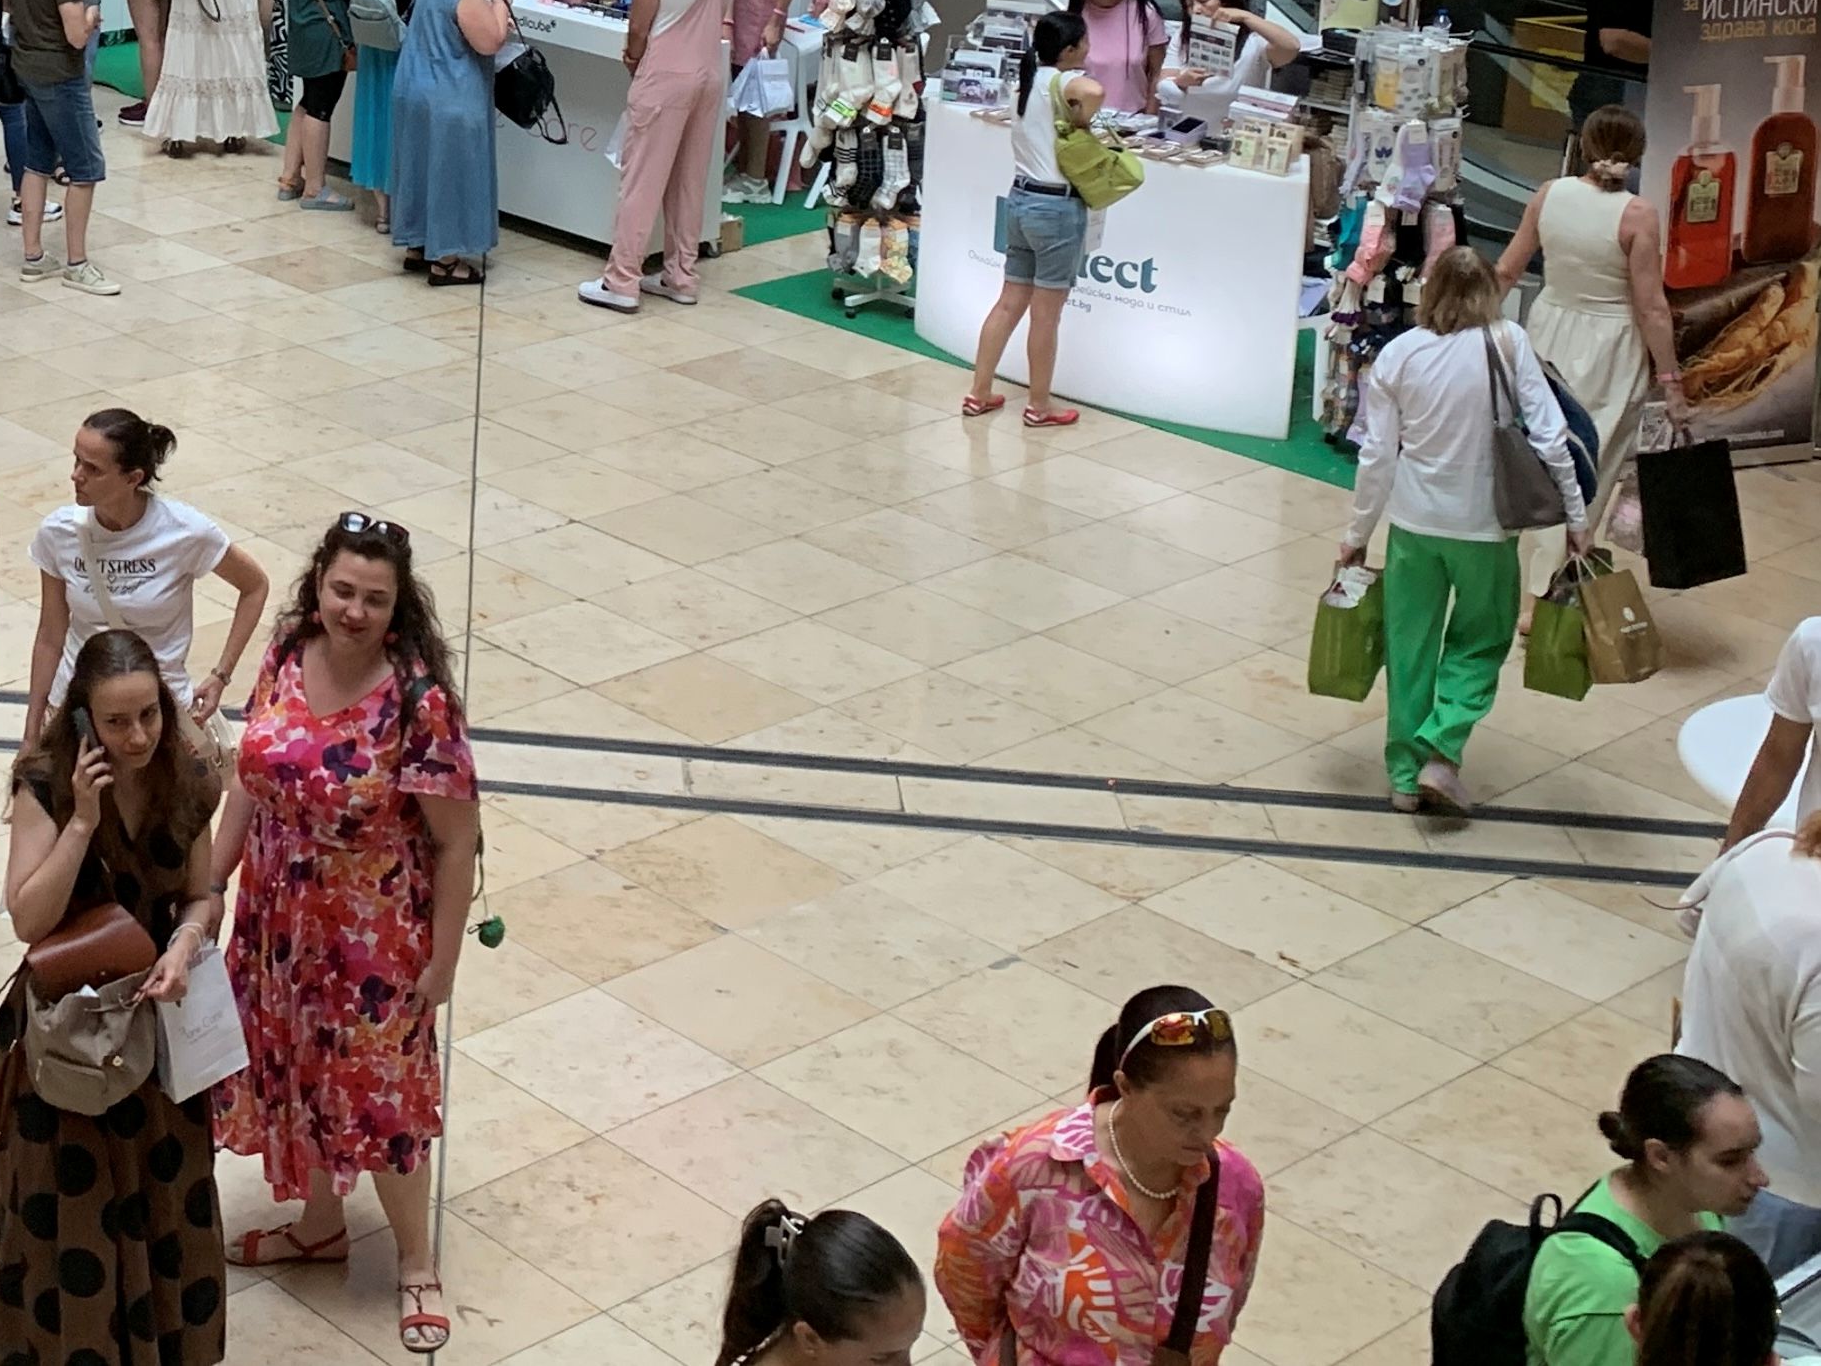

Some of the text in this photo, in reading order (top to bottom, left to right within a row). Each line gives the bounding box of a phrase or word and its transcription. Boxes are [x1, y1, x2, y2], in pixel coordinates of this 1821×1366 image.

[1700, 17, 1817, 41] здрава коса
[107, 558, 156, 574] STRESS
